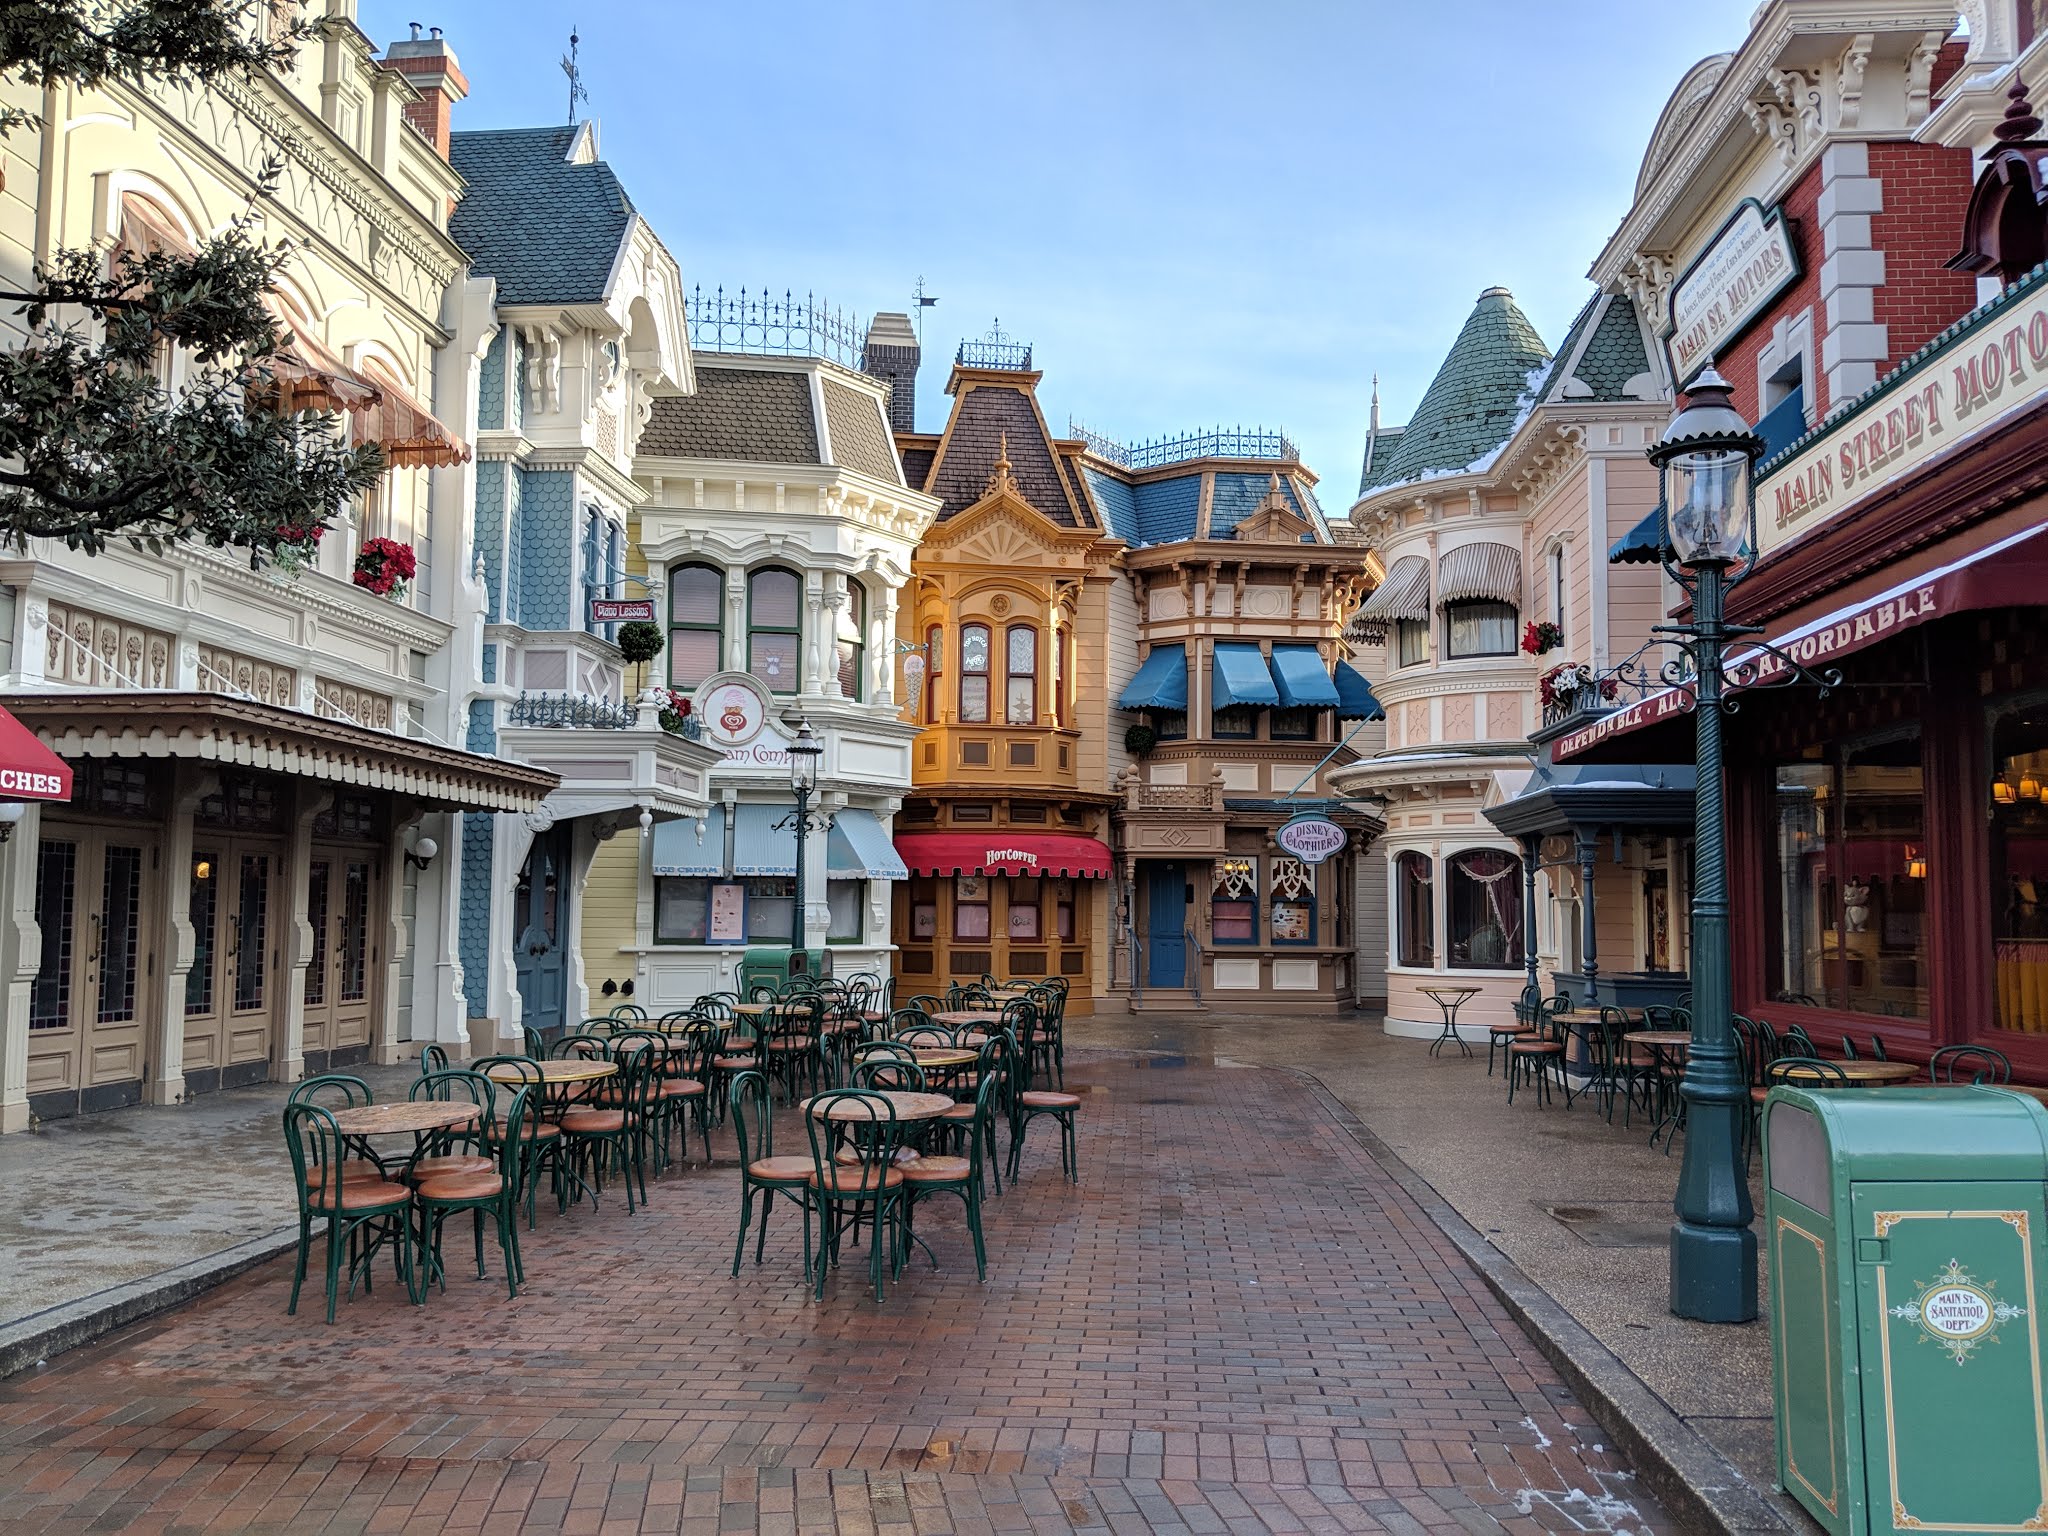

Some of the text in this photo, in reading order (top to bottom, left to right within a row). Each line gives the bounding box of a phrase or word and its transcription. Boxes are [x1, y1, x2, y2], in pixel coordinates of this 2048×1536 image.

[1677, 240, 1785, 367] MAIN ST. MOTORS
[1775, 454, 1832, 529] MAIN
[1839, 381, 1944, 490] STREET
[597, 605, 649, 617] Piano Lessons
[1560, 707, 1643, 756] DEPENDABLE
[1657, 690, 1685, 716] ALL
[0, 769, 62, 794] CHES
[1296, 824, 1331, 837] DISNEY
[1285, 831, 1340, 852] CLOTHIERS
[677, 866, 718, 874] CREAM
[757, 866, 797, 874] CREAM
[1939, 1293, 1976, 1304] MAIN ST.
[1930, 1304, 1985, 1320] SANITATION
[1945, 1320, 1972, 1331] DEPT.
